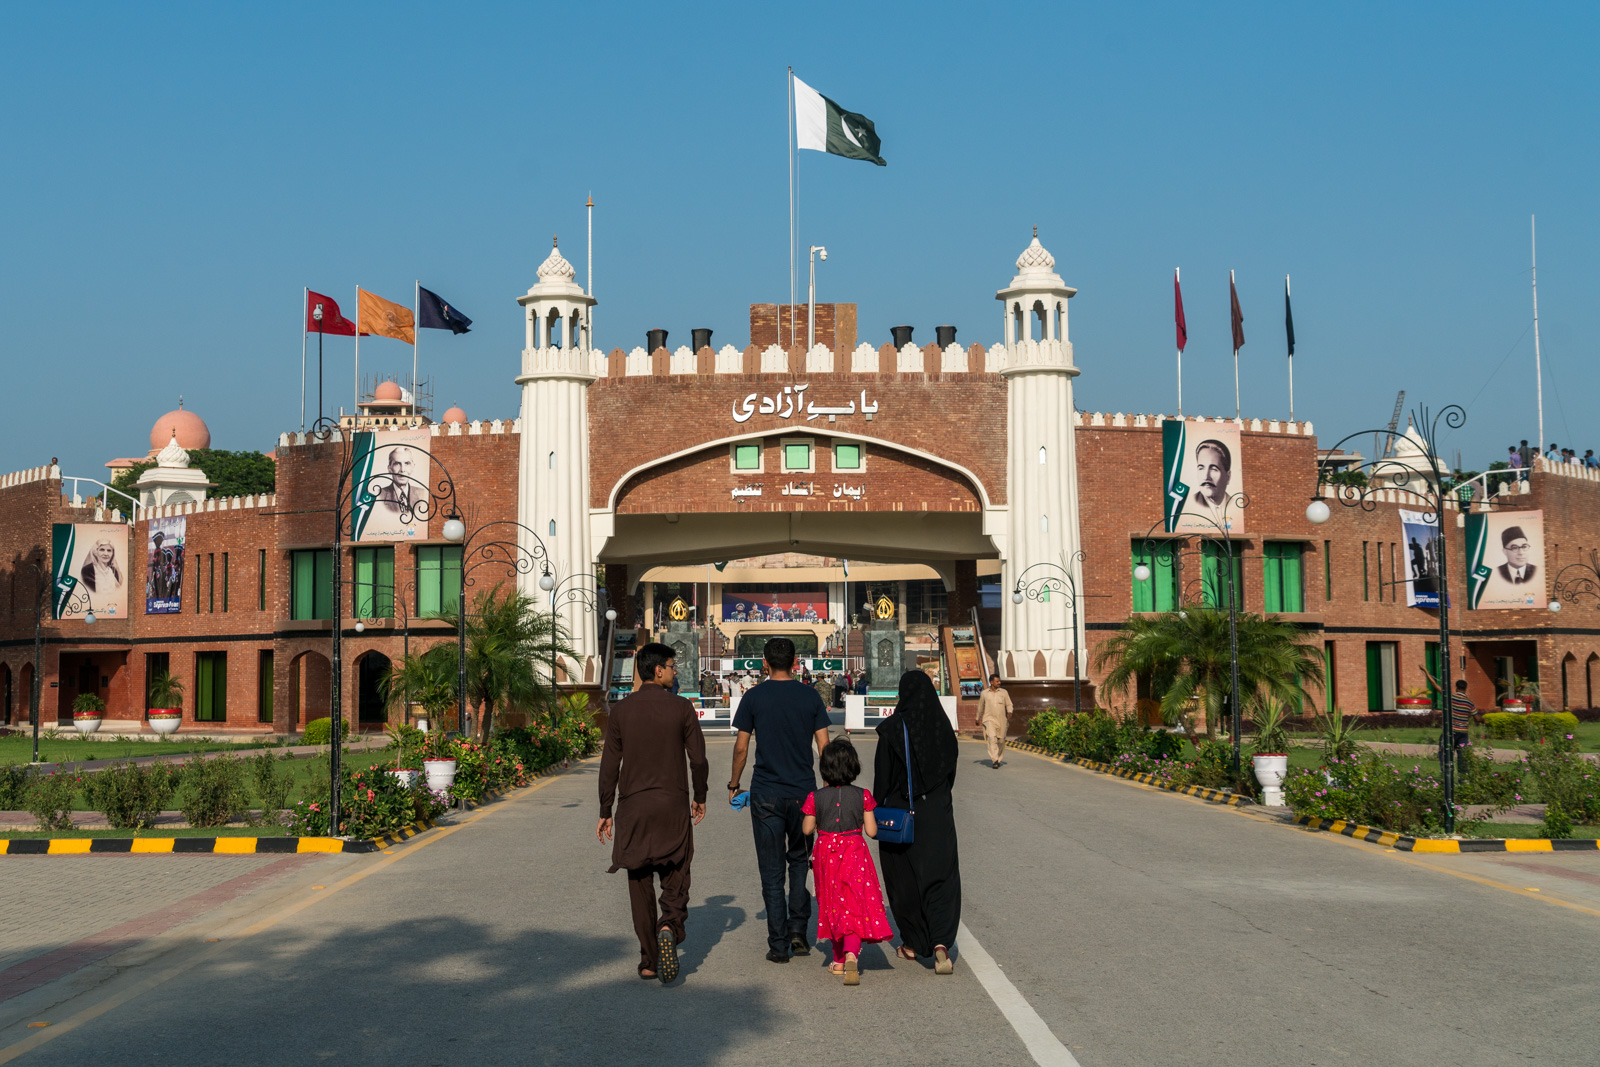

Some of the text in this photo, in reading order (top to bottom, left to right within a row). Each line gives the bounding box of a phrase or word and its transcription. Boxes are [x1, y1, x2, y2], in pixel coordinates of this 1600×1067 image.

[732, 383, 809, 423] آزادی
[731, 482, 866, 503] ایمان اتحاد تنظیم
